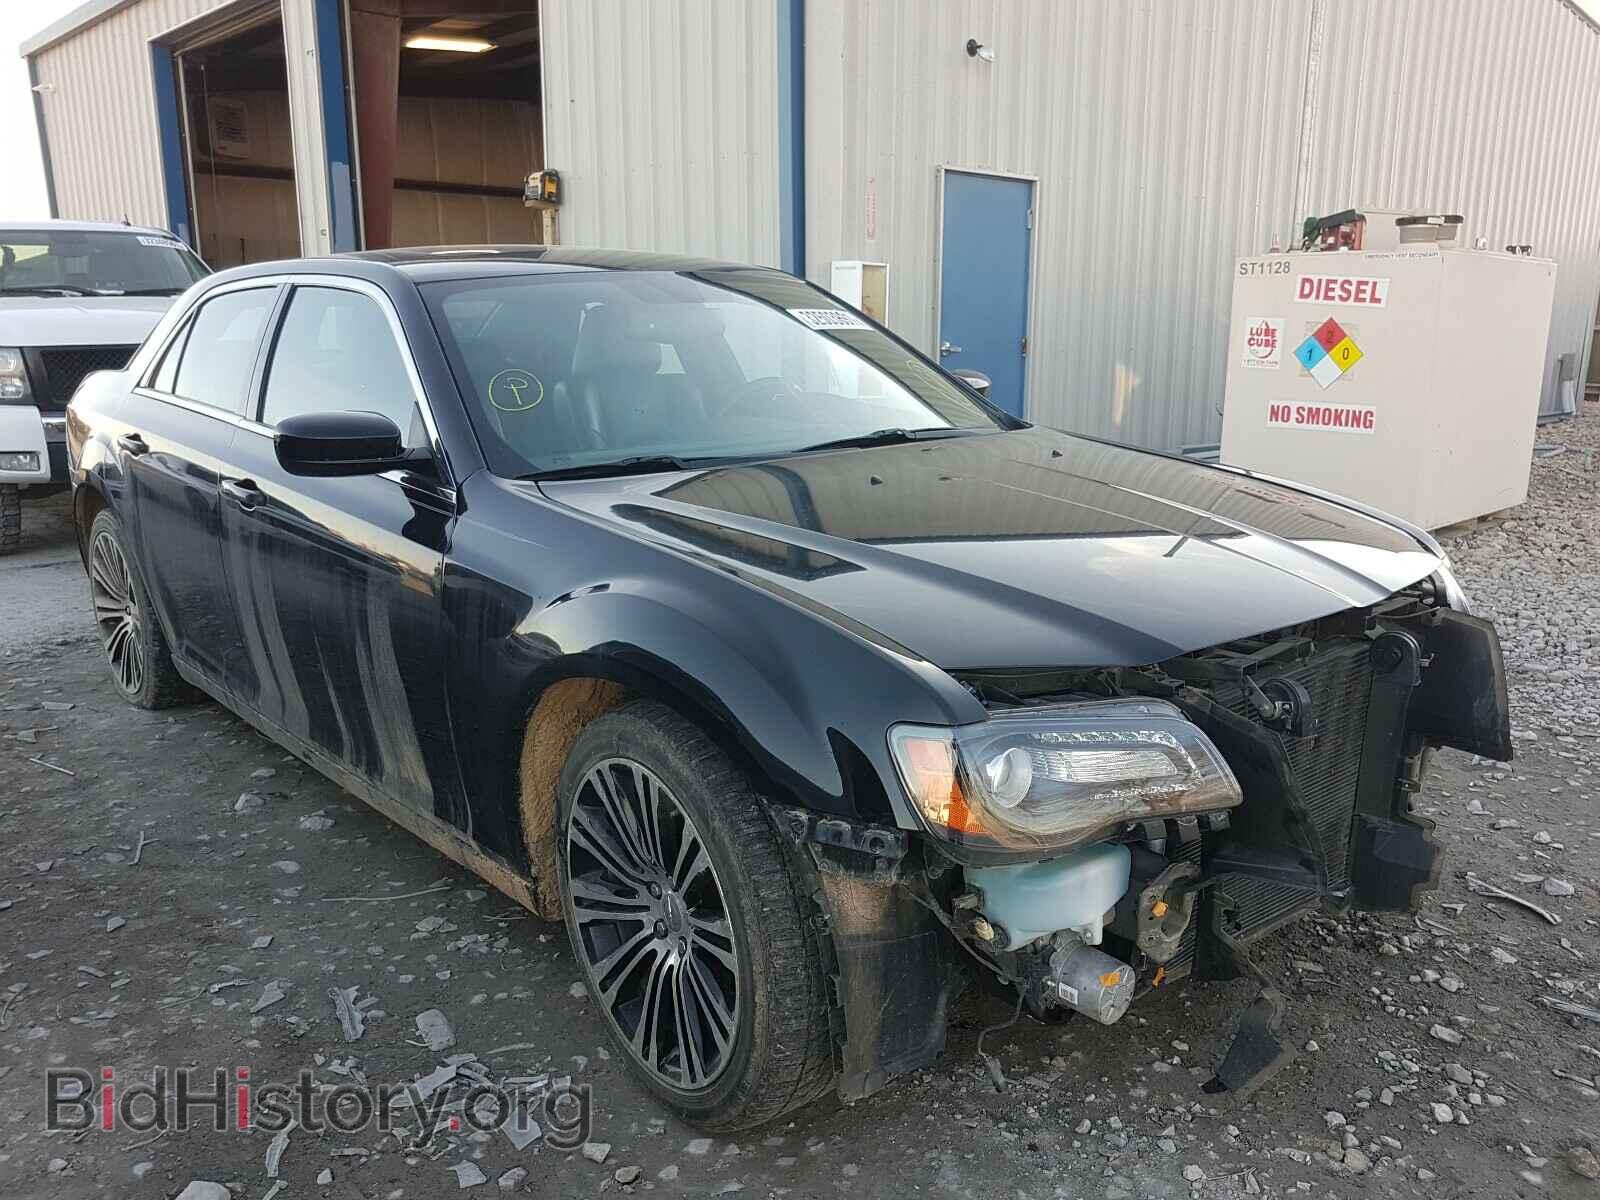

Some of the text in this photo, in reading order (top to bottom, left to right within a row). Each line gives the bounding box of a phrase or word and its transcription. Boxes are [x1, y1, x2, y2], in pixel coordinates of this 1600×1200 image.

[1239, 261, 1291, 275] ST1128
[1298, 277, 1382, 304] DIESEL
[1250, 327, 1278, 337] LUBE
[1327, 330, 1335, 344] 2
[1247, 337, 1278, 348] CUBE
[1305, 347, 1313, 361] 1
[1269, 404, 1375, 429] NO SMOKING
